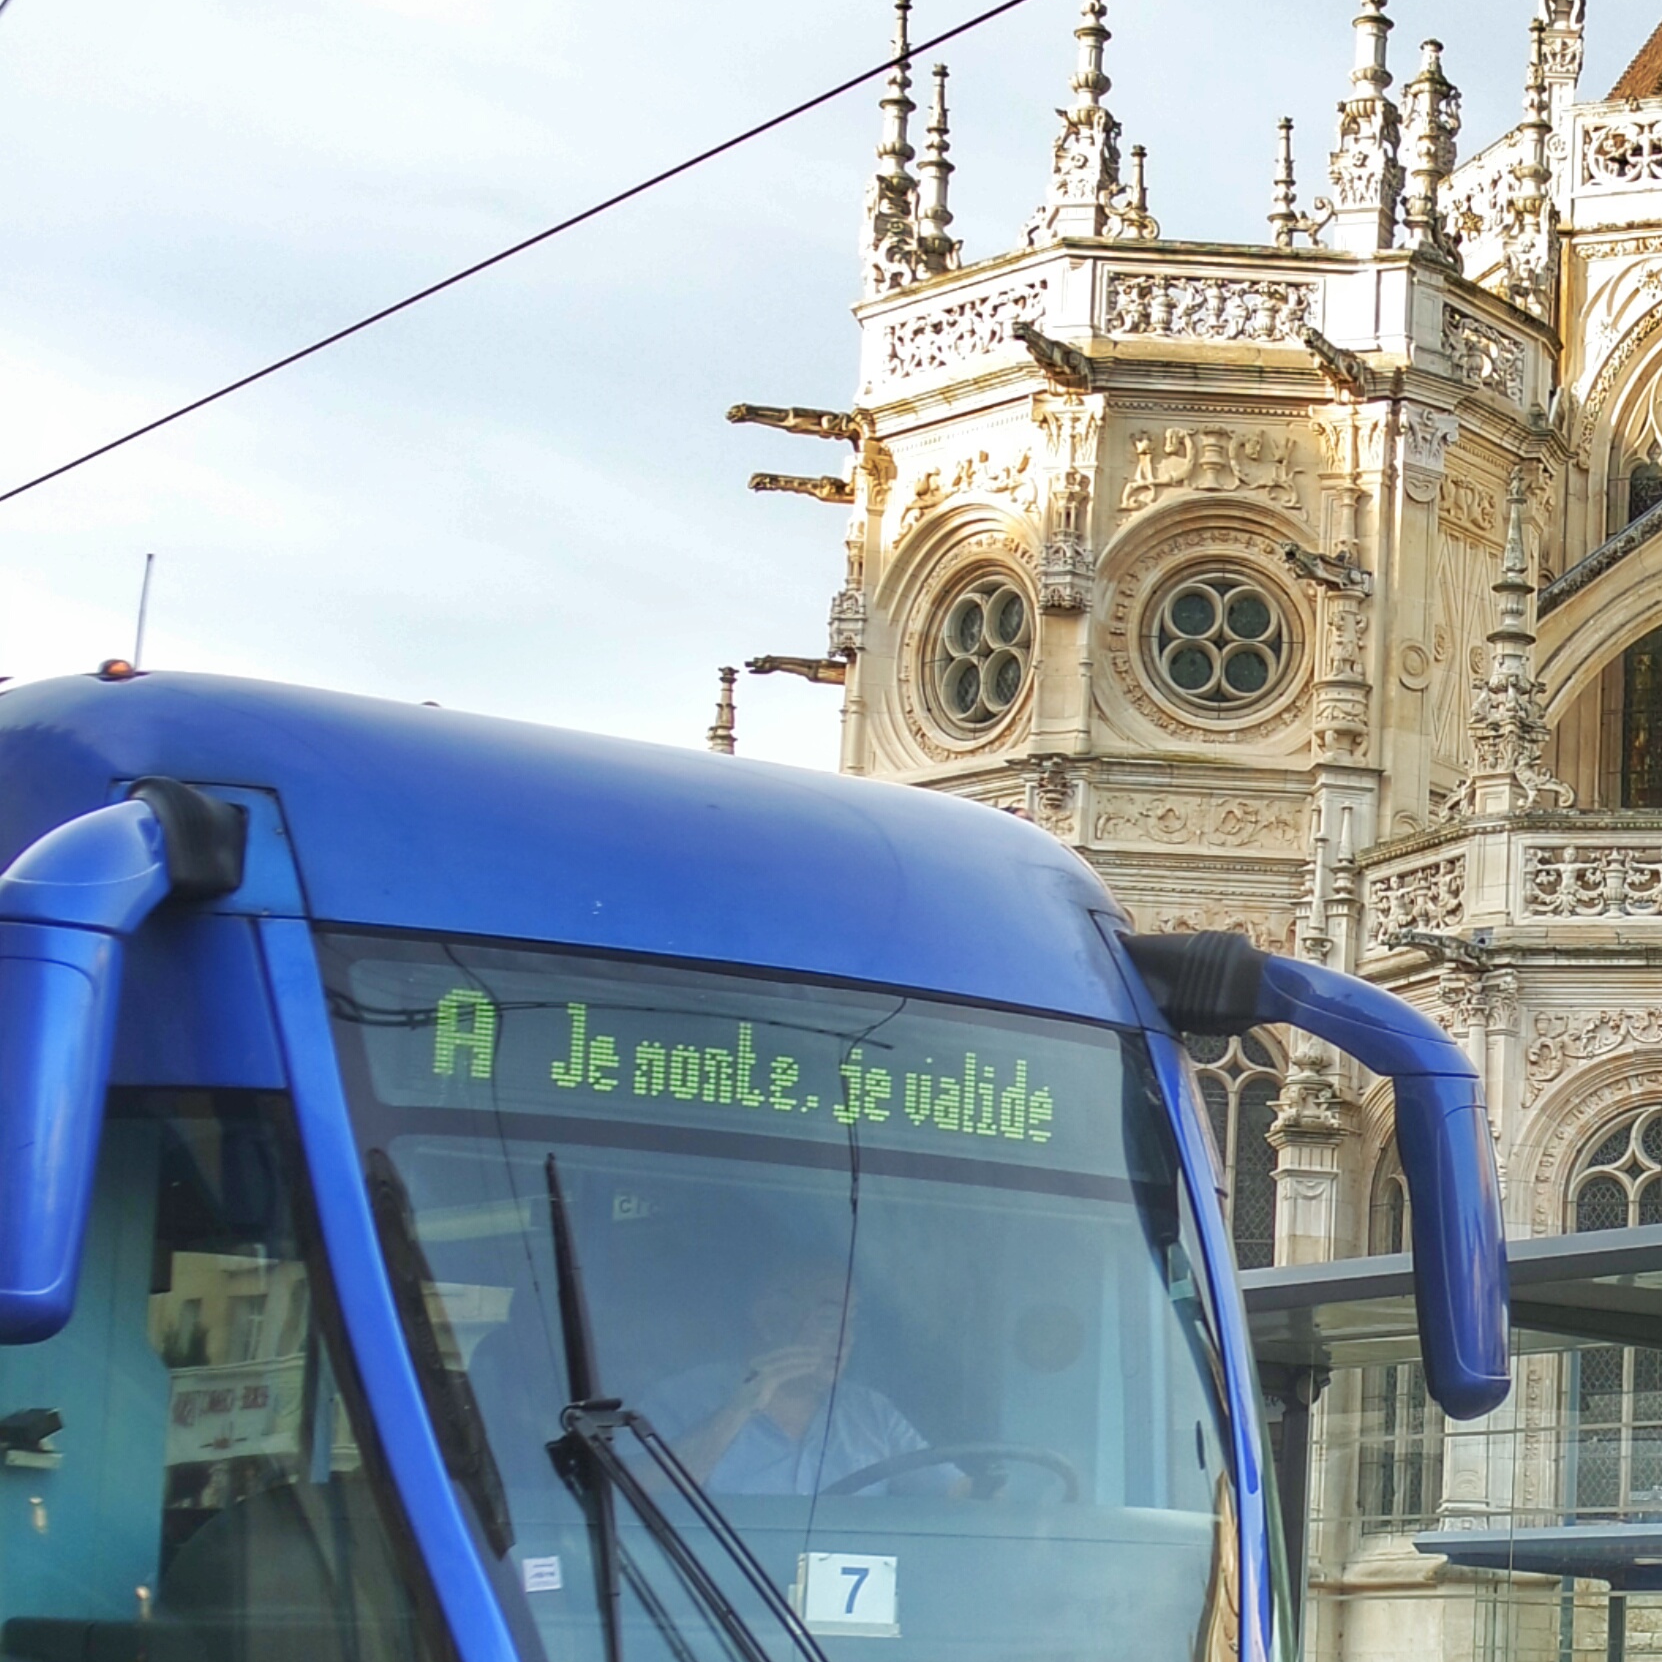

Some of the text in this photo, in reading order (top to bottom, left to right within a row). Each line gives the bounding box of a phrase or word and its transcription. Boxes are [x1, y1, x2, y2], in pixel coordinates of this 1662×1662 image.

[433, 989, 495, 1078] A
[551, 1002, 620, 1091] Je
[833, 1049, 891, 1124] je
[904, 1052, 1053, 1142] valide
[840, 1567, 870, 1615] 7
